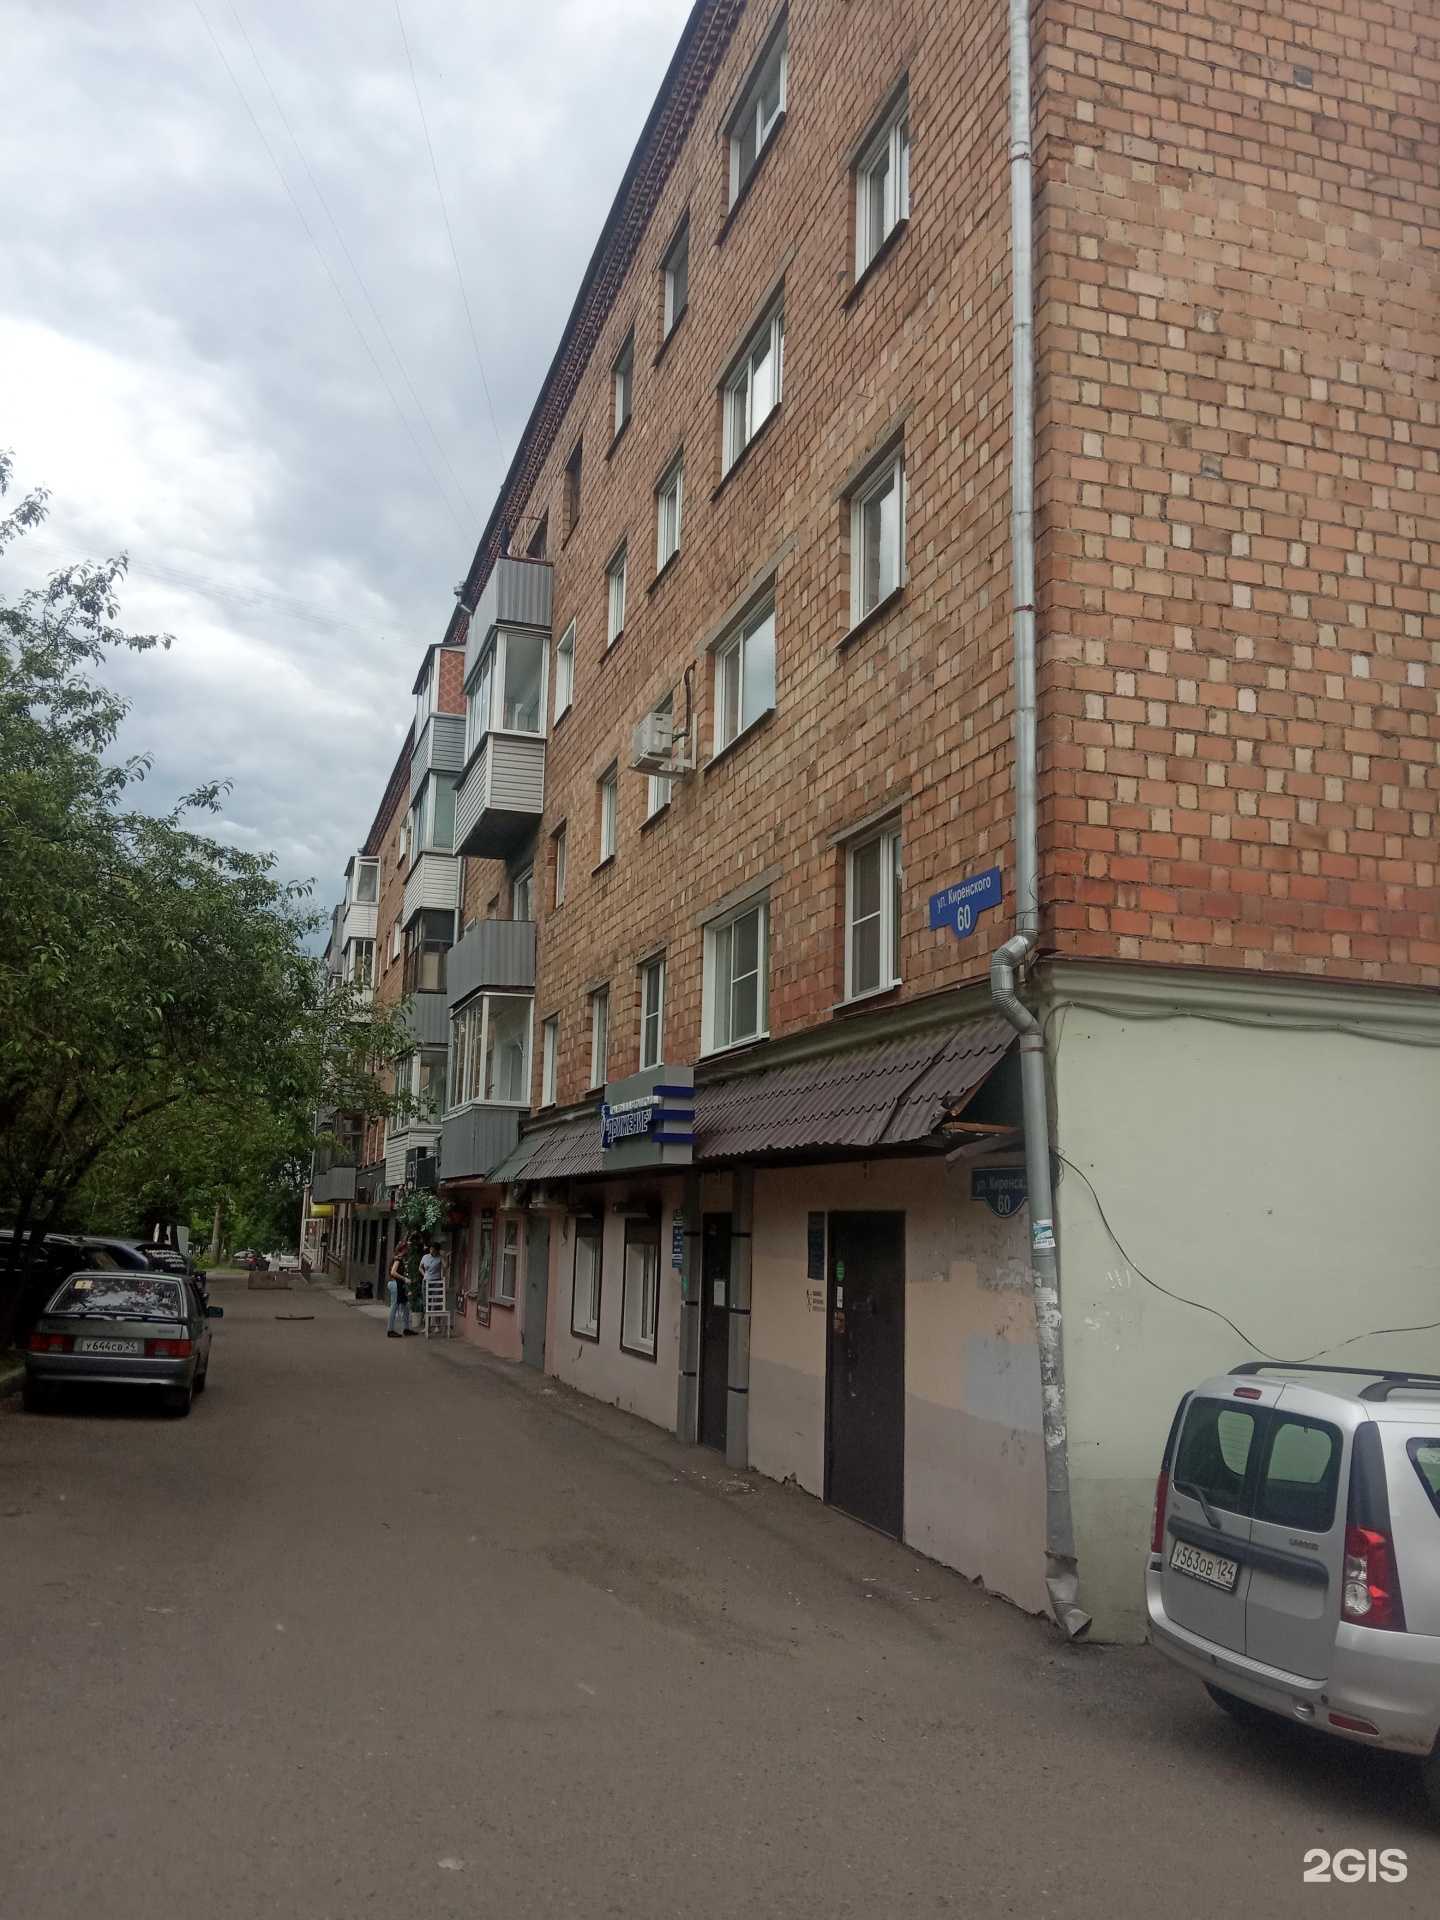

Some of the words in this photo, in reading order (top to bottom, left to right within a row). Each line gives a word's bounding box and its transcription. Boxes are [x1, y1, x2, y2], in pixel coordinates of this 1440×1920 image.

[937, 896, 946, 913] ул.
[948, 875, 991, 905] Киренского
[957, 904, 971, 931] 60
[998, 1194, 1011, 1213] 60
[1217, 1559, 1234, 1581] 124
